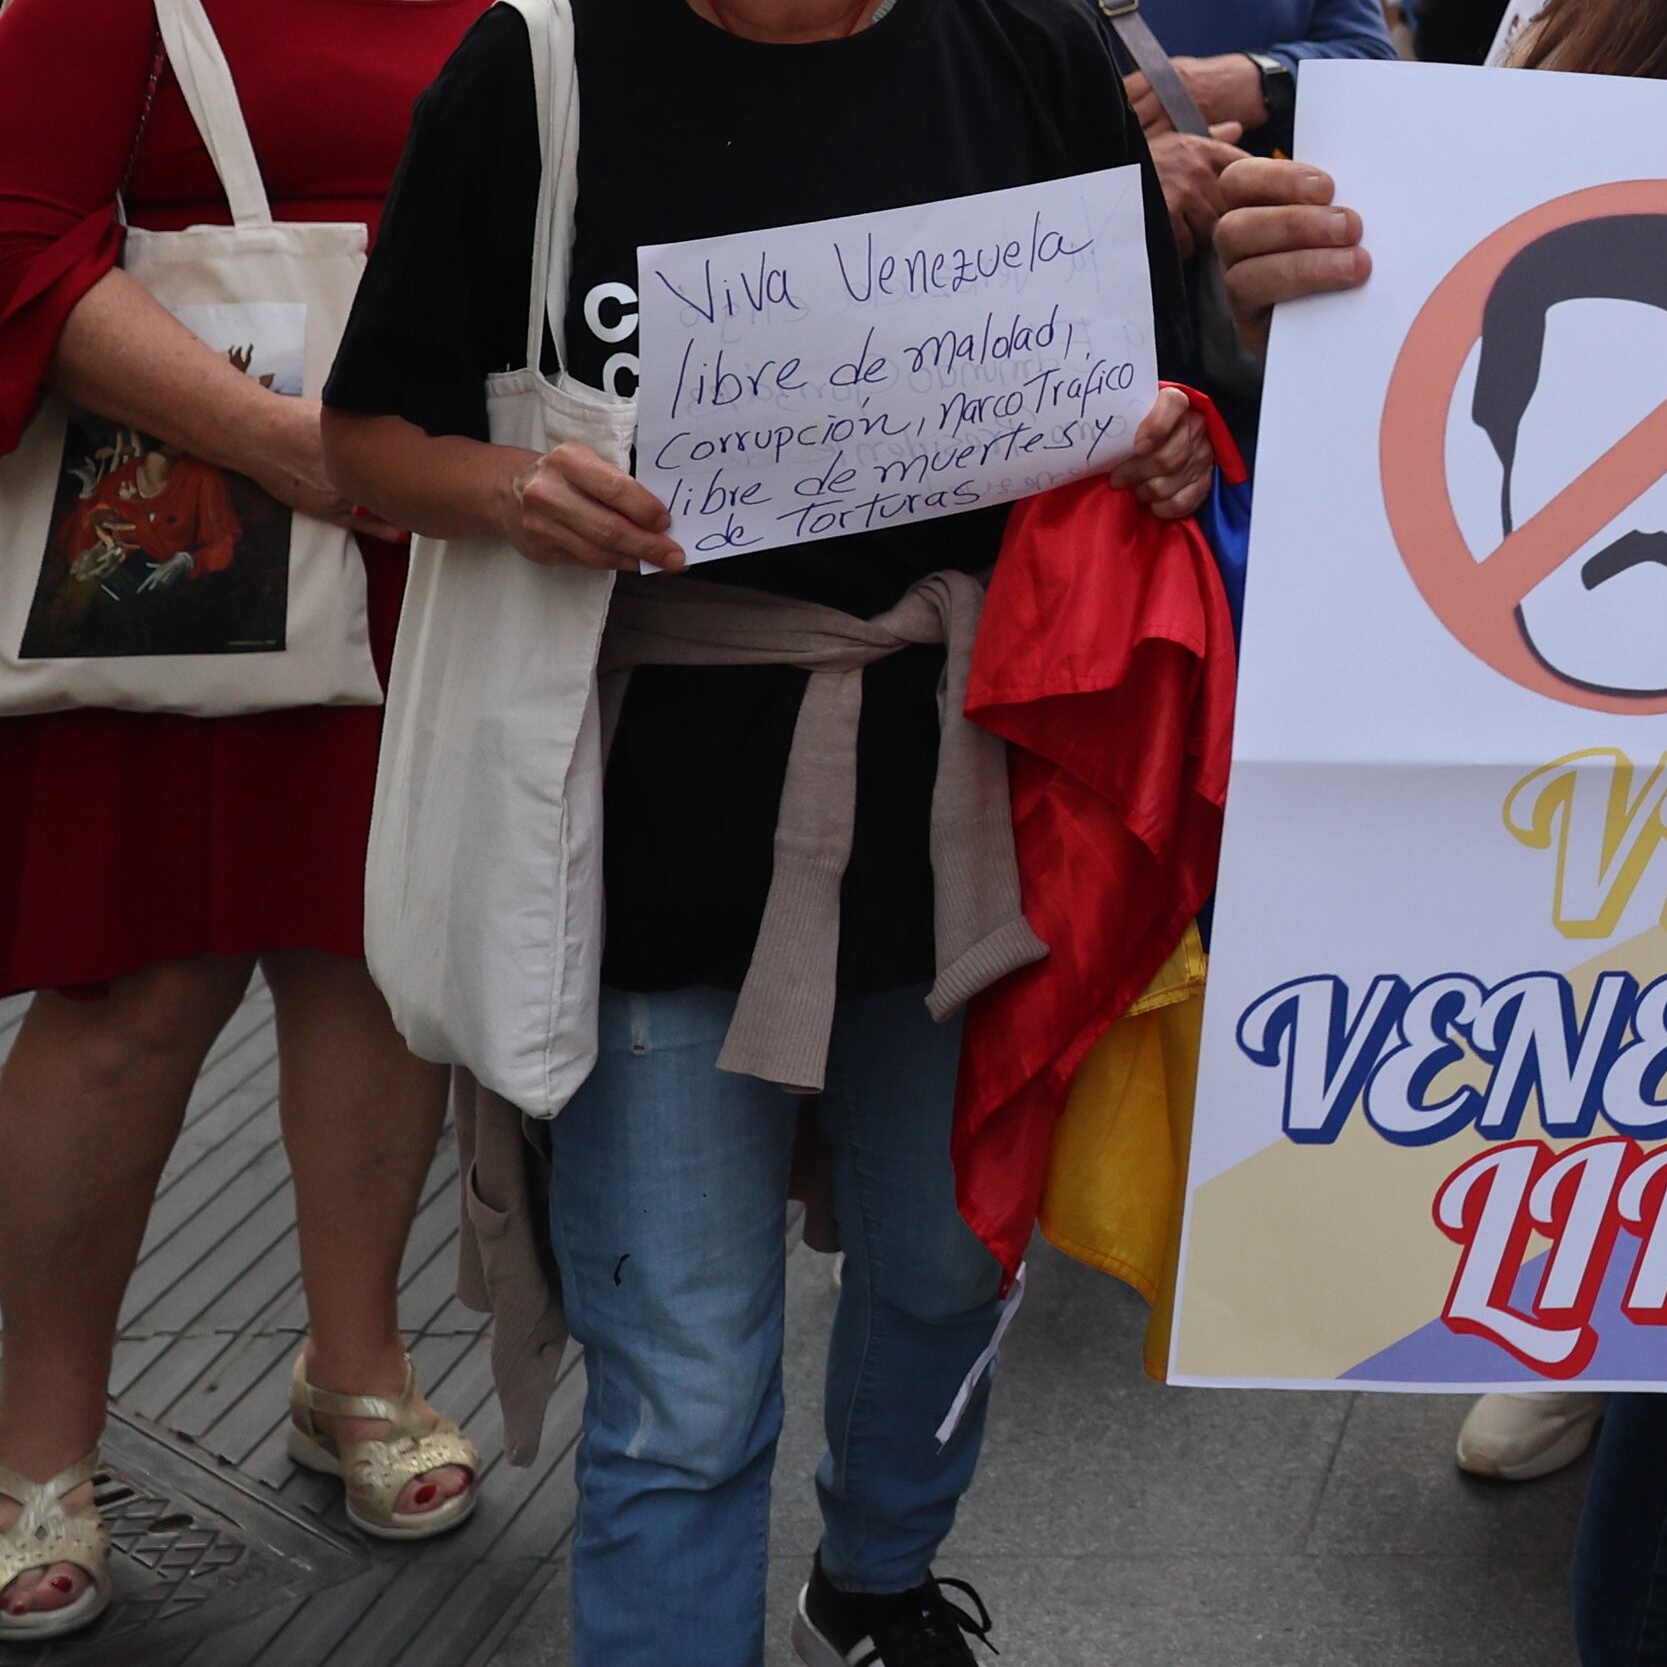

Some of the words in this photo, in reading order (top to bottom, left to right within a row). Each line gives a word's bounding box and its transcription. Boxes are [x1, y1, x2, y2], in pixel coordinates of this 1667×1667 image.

[833, 211, 1094, 304] Venezuela
[671, 337, 808, 419] libre
[829, 326, 889, 387] de
[668, 467, 773, 516] libre
[793, 450, 858, 496] de
[695, 512, 765, 552] de
[776, 477, 982, 539] Torturas
